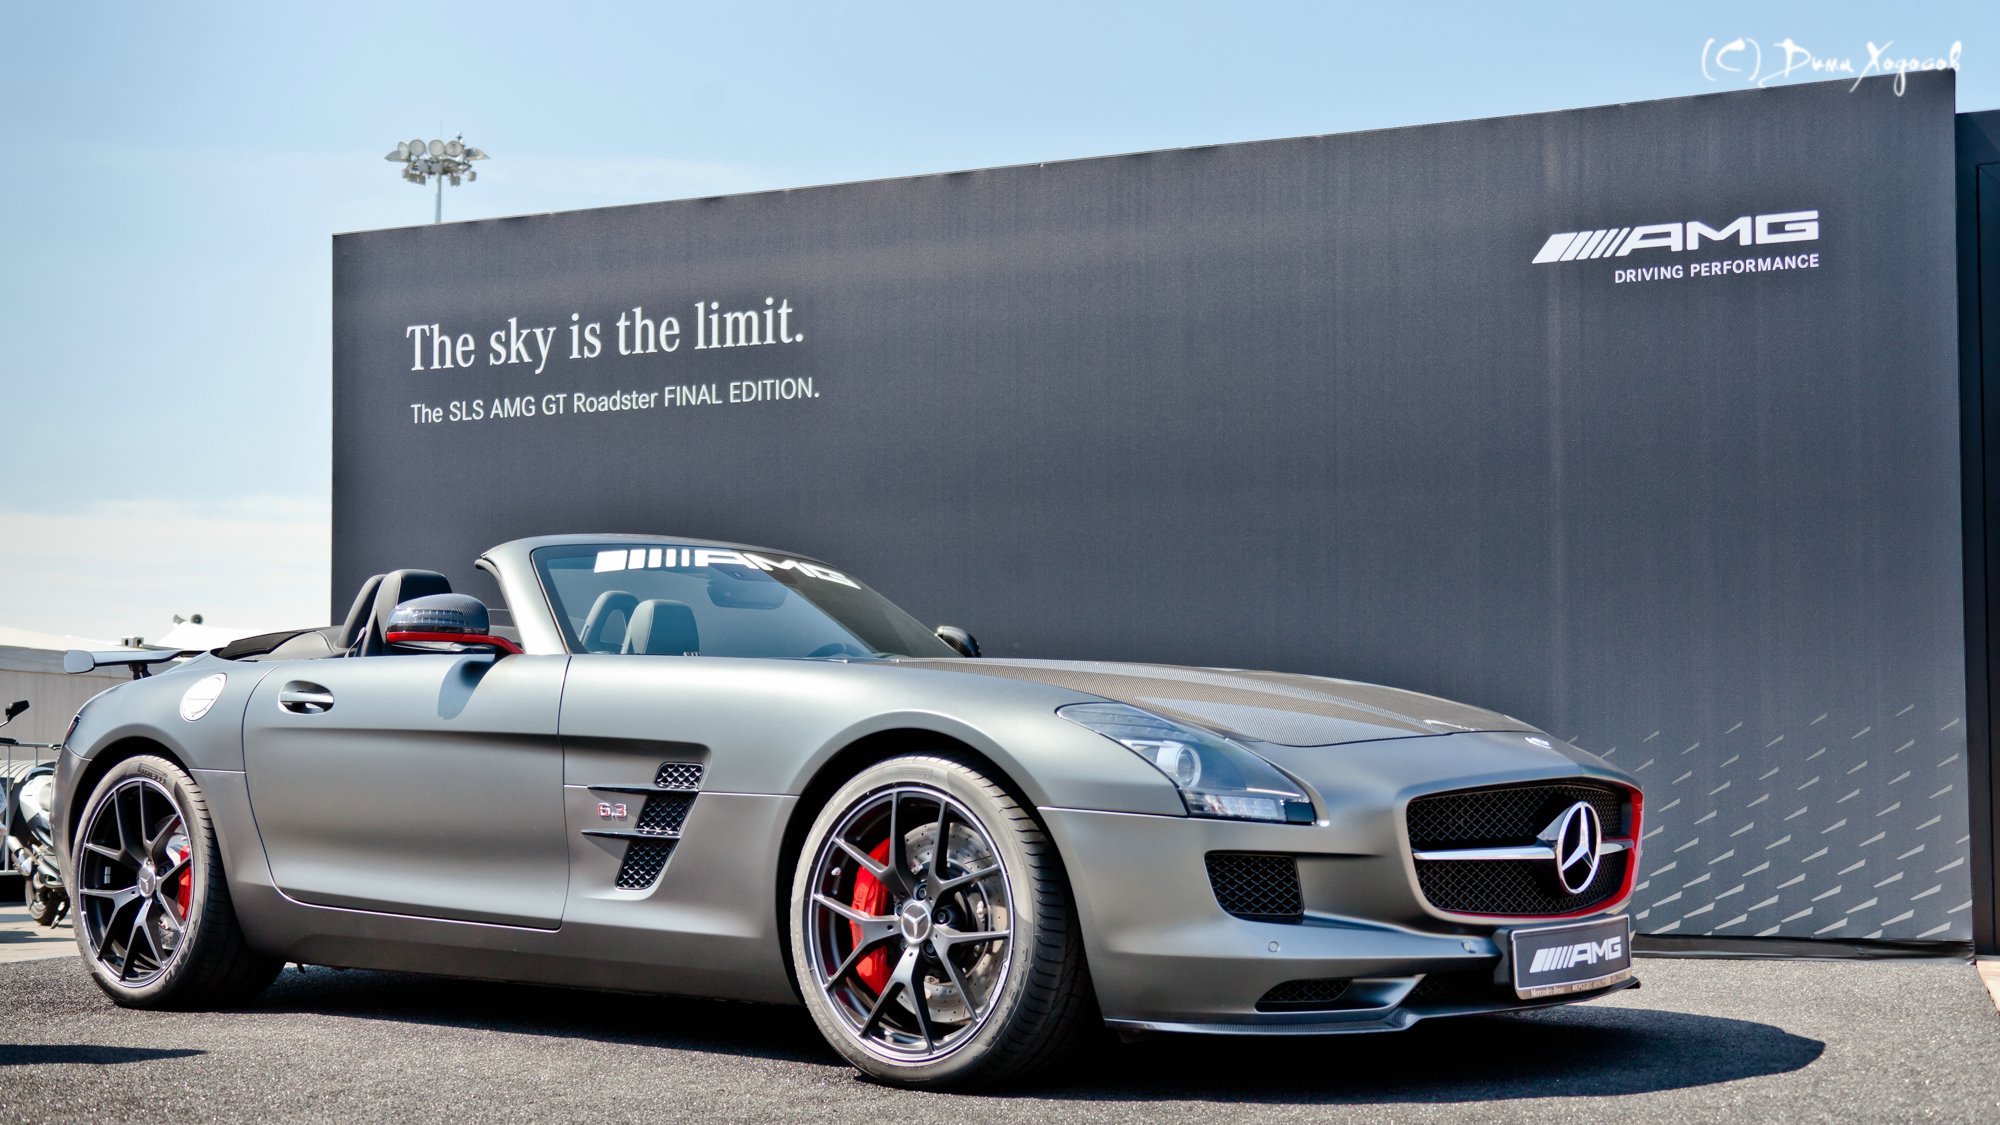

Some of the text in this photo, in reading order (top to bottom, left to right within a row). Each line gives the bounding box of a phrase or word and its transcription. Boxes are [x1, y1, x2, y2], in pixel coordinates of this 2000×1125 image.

[1615, 211, 1819, 257] AMG
[1615, 254, 1819, 283] DRIVING PERFORMANCE
[406, 297, 803, 374] The sky is the limit.
[411, 377, 819, 423] The SLS AMG GT Roadster FINAL EDITION.
[694, 549, 861, 589] AMG
[598, 803, 627, 817] 6.3
[1568, 936, 1622, 968] AMG
